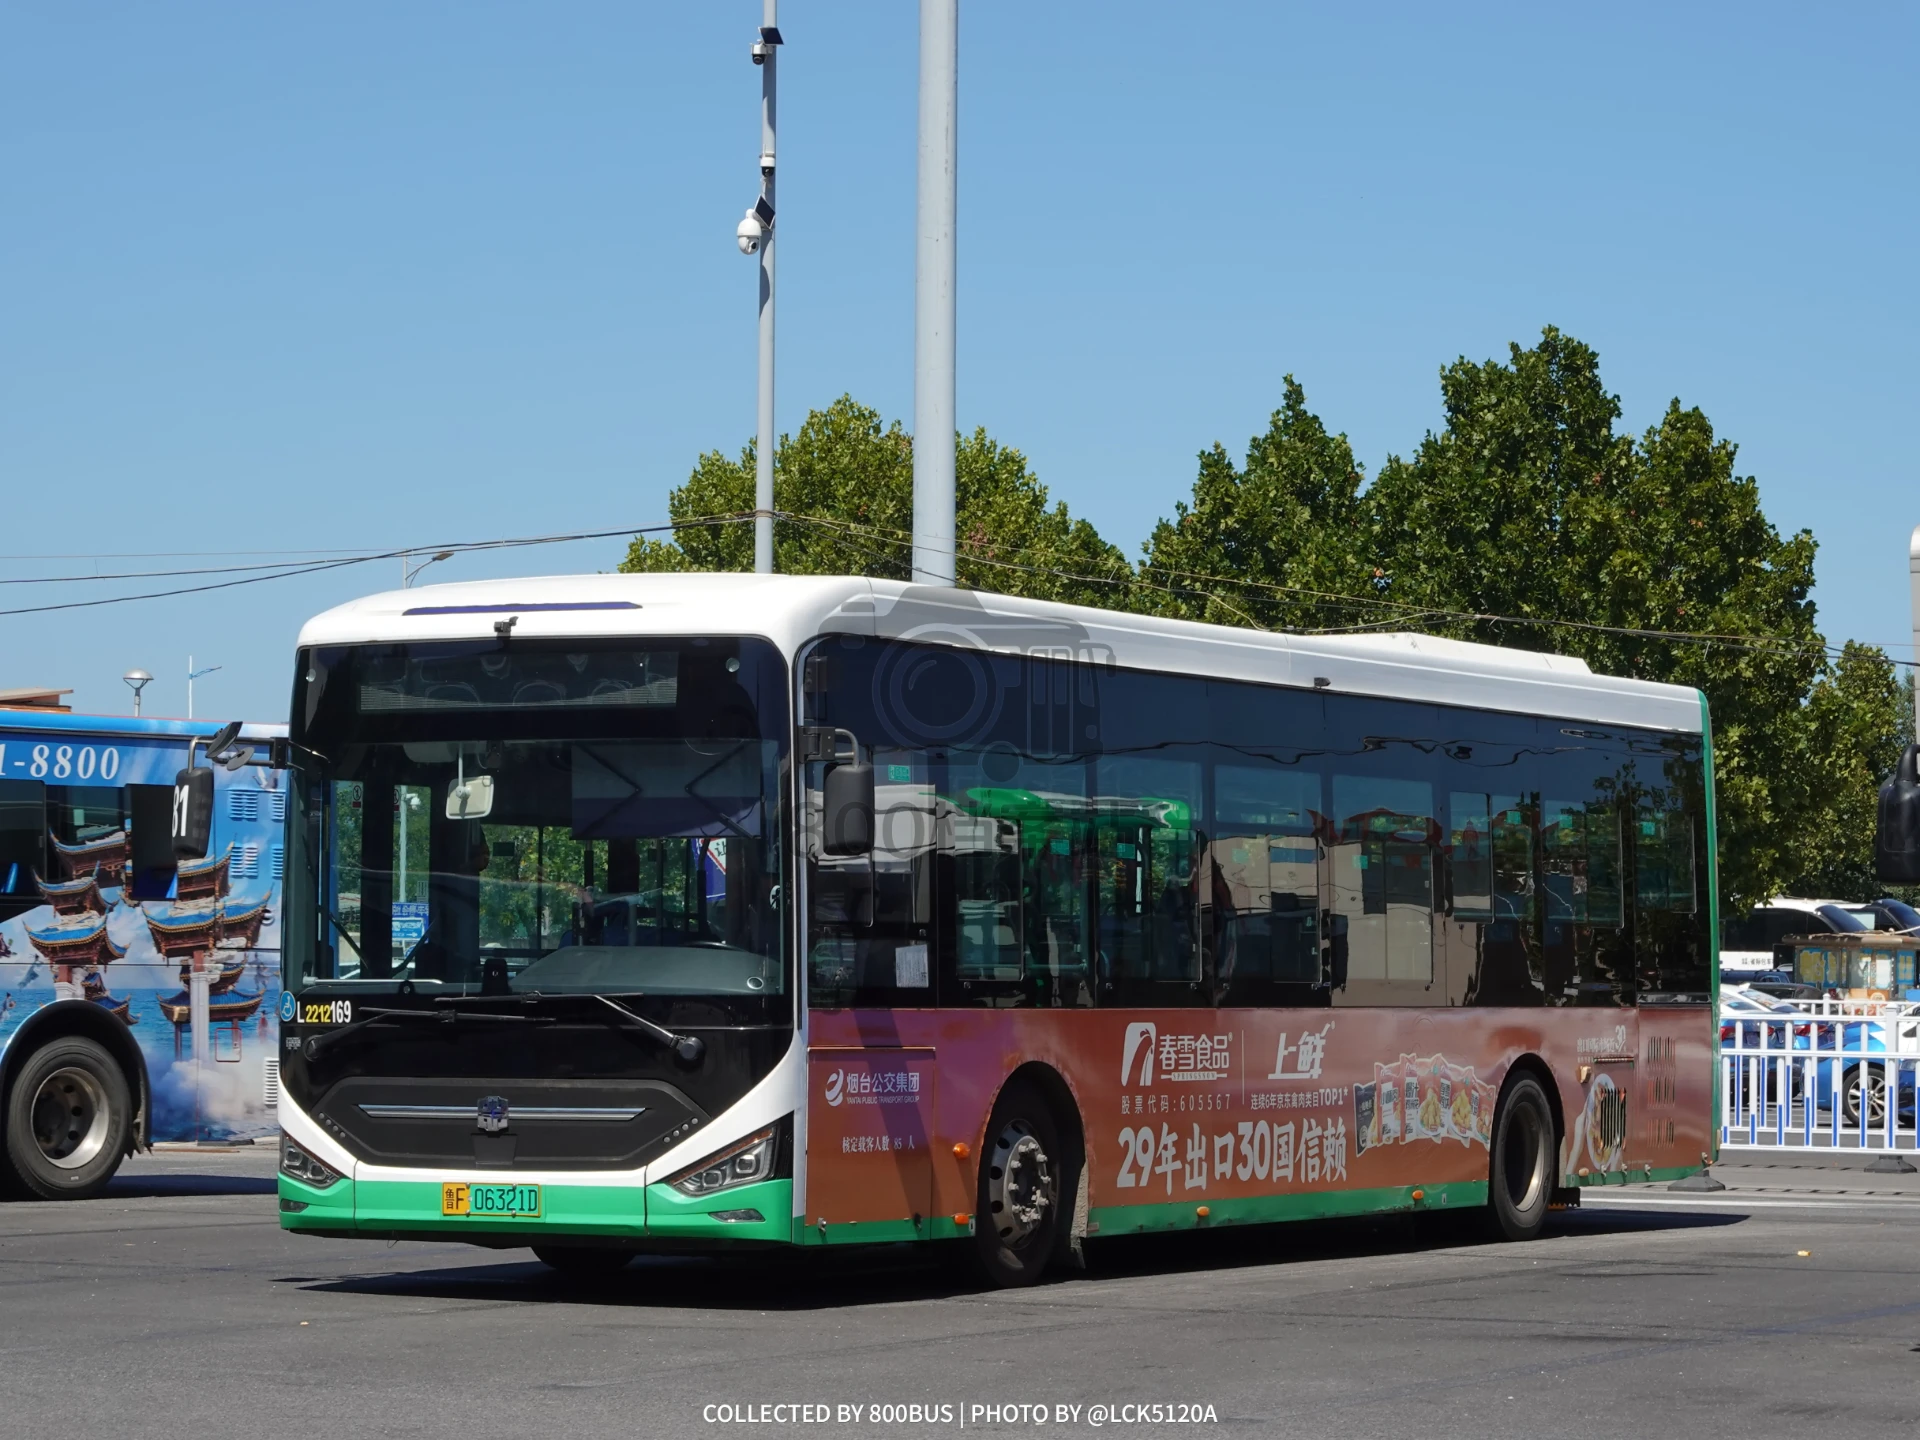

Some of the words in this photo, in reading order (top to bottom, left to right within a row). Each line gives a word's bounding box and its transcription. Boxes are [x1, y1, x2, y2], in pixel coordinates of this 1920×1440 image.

[1159, 1034, 1230, 1071] 春雪食品
[846, 1072, 920, 1094] 烟台公交集团
[1116, 1116, 1347, 1196] 29年出口30国信赖
